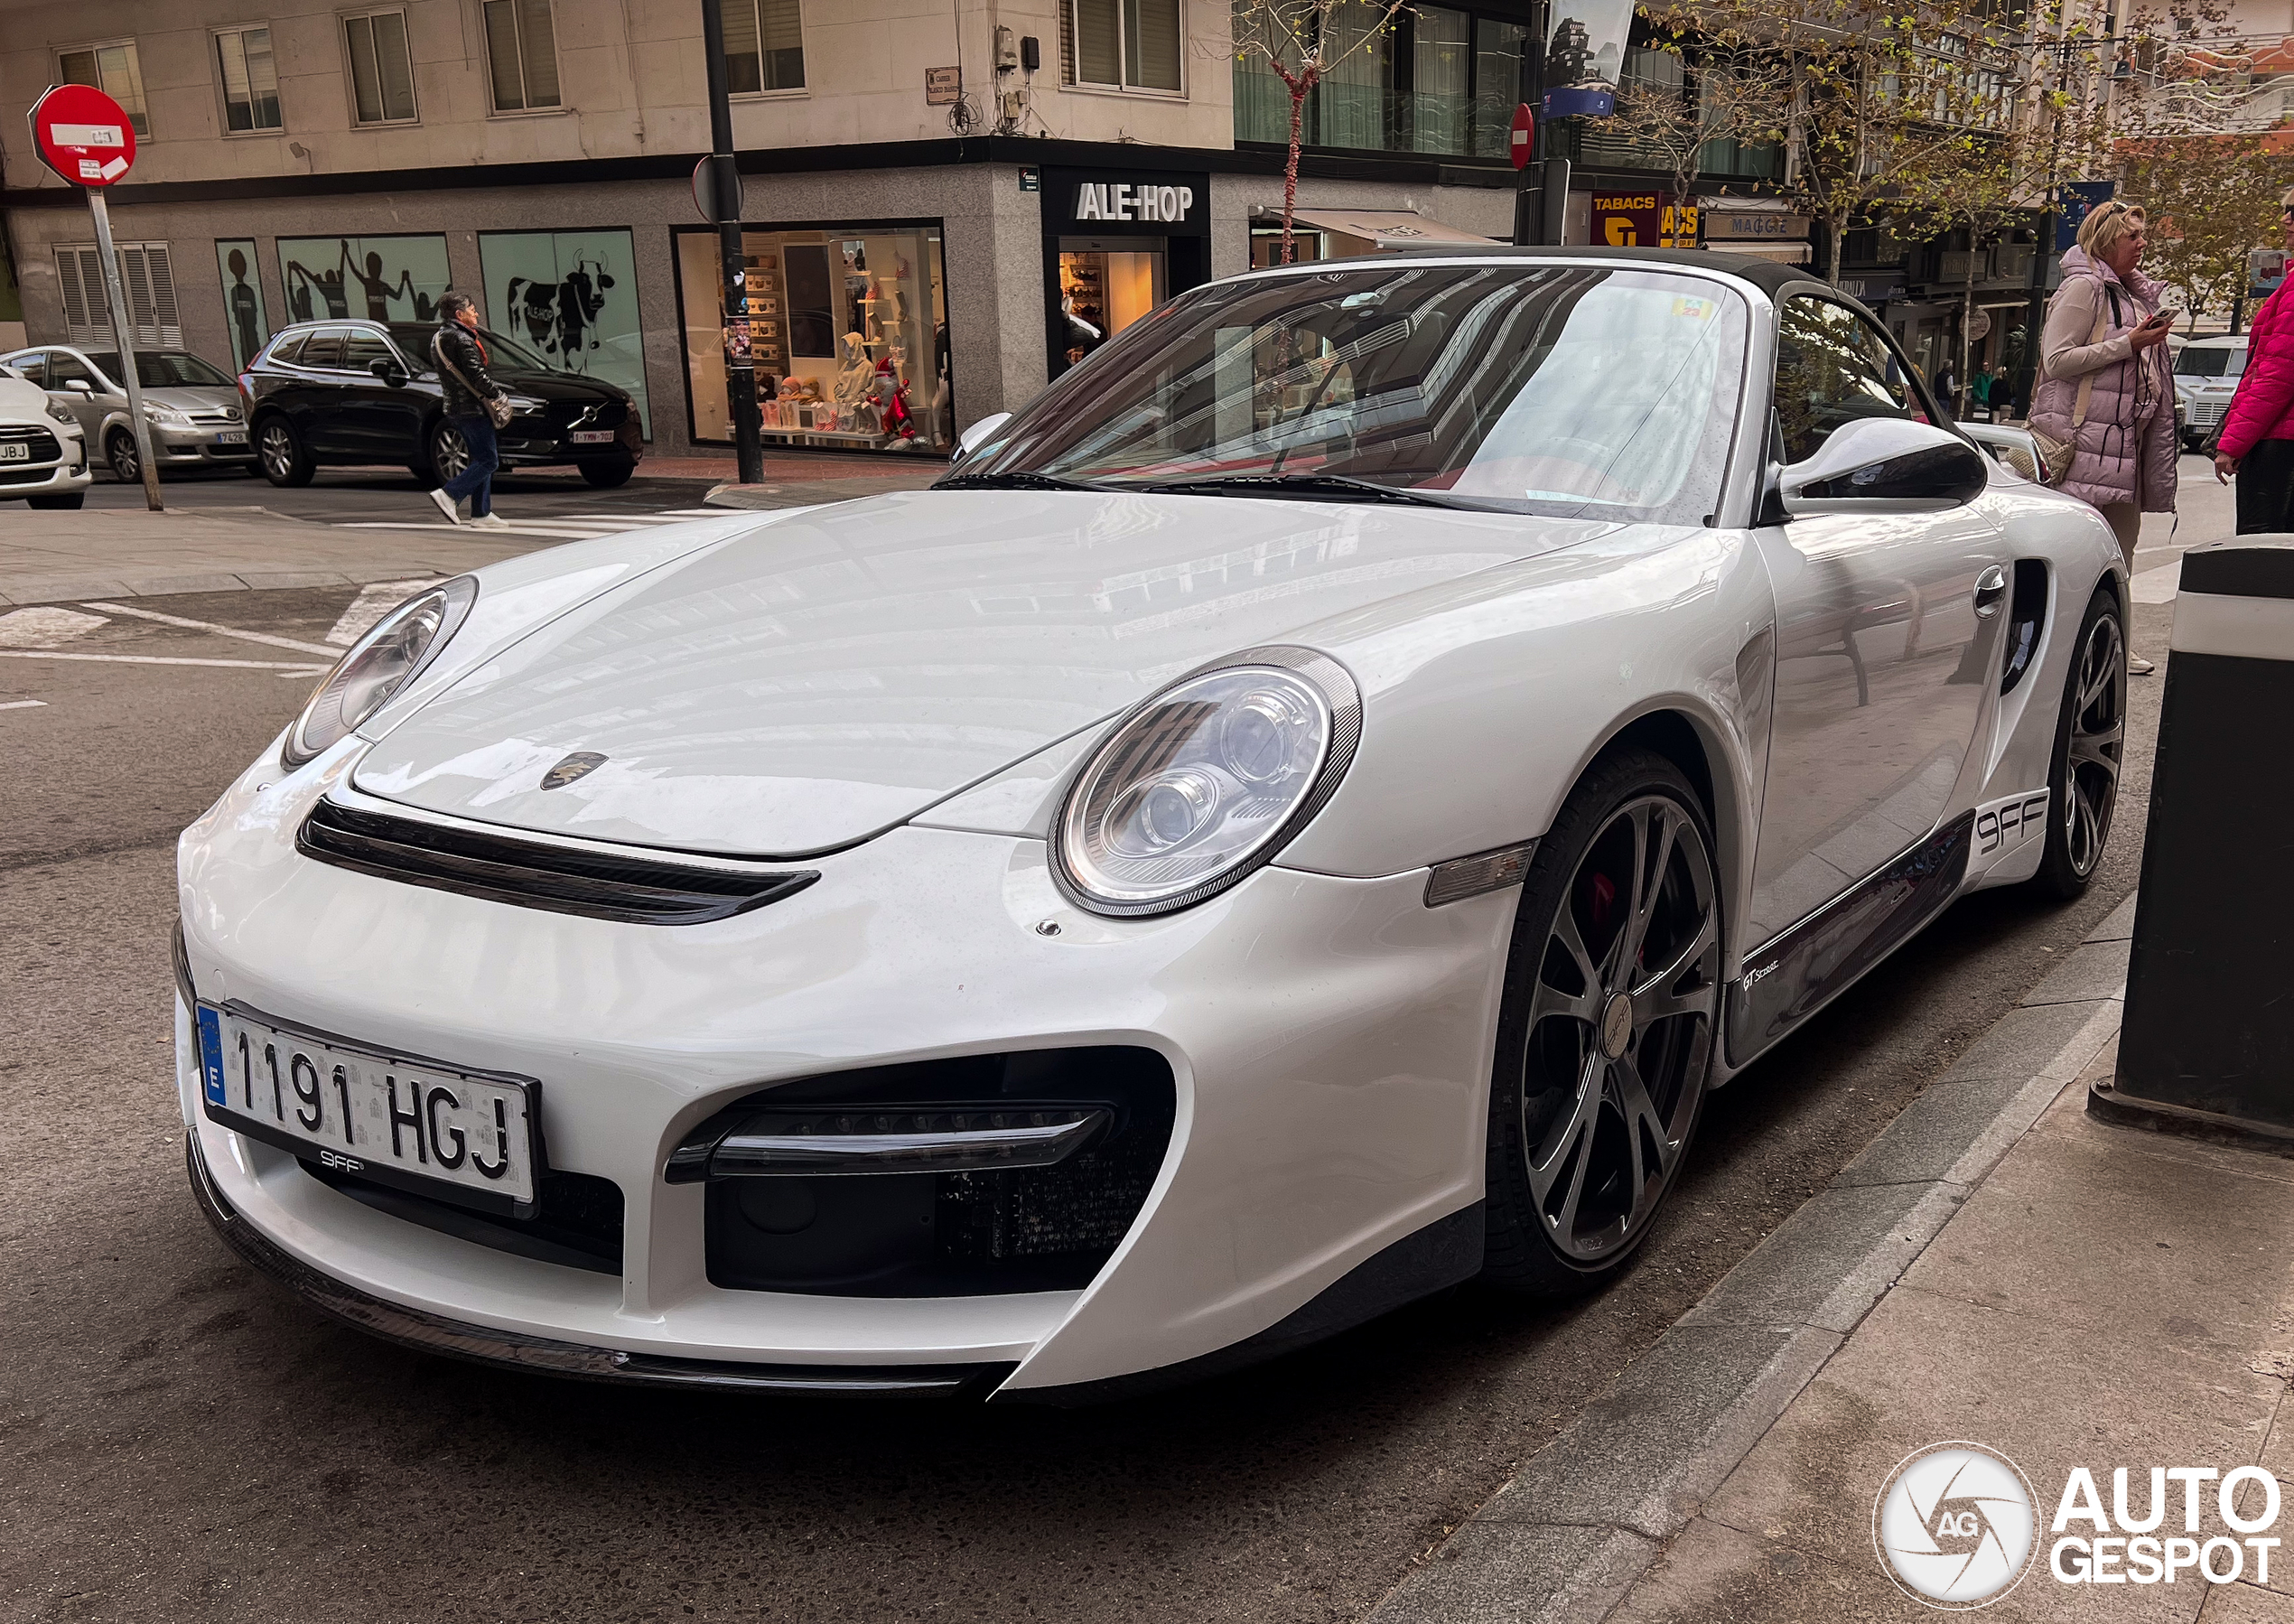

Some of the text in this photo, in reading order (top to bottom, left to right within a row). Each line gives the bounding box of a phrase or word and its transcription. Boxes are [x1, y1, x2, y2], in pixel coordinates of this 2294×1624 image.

[1076, 183, 1193, 222] ALE-HOP
[1594, 196, 1655, 210] TABACS
[222, 433, 244, 443] 7428
[0, 445, 26, 458] JBJ
[1743, 968, 1757, 992] GT
[209, 1066, 220, 1089] E
[238, 1031, 508, 1180] 1191 HGJ
